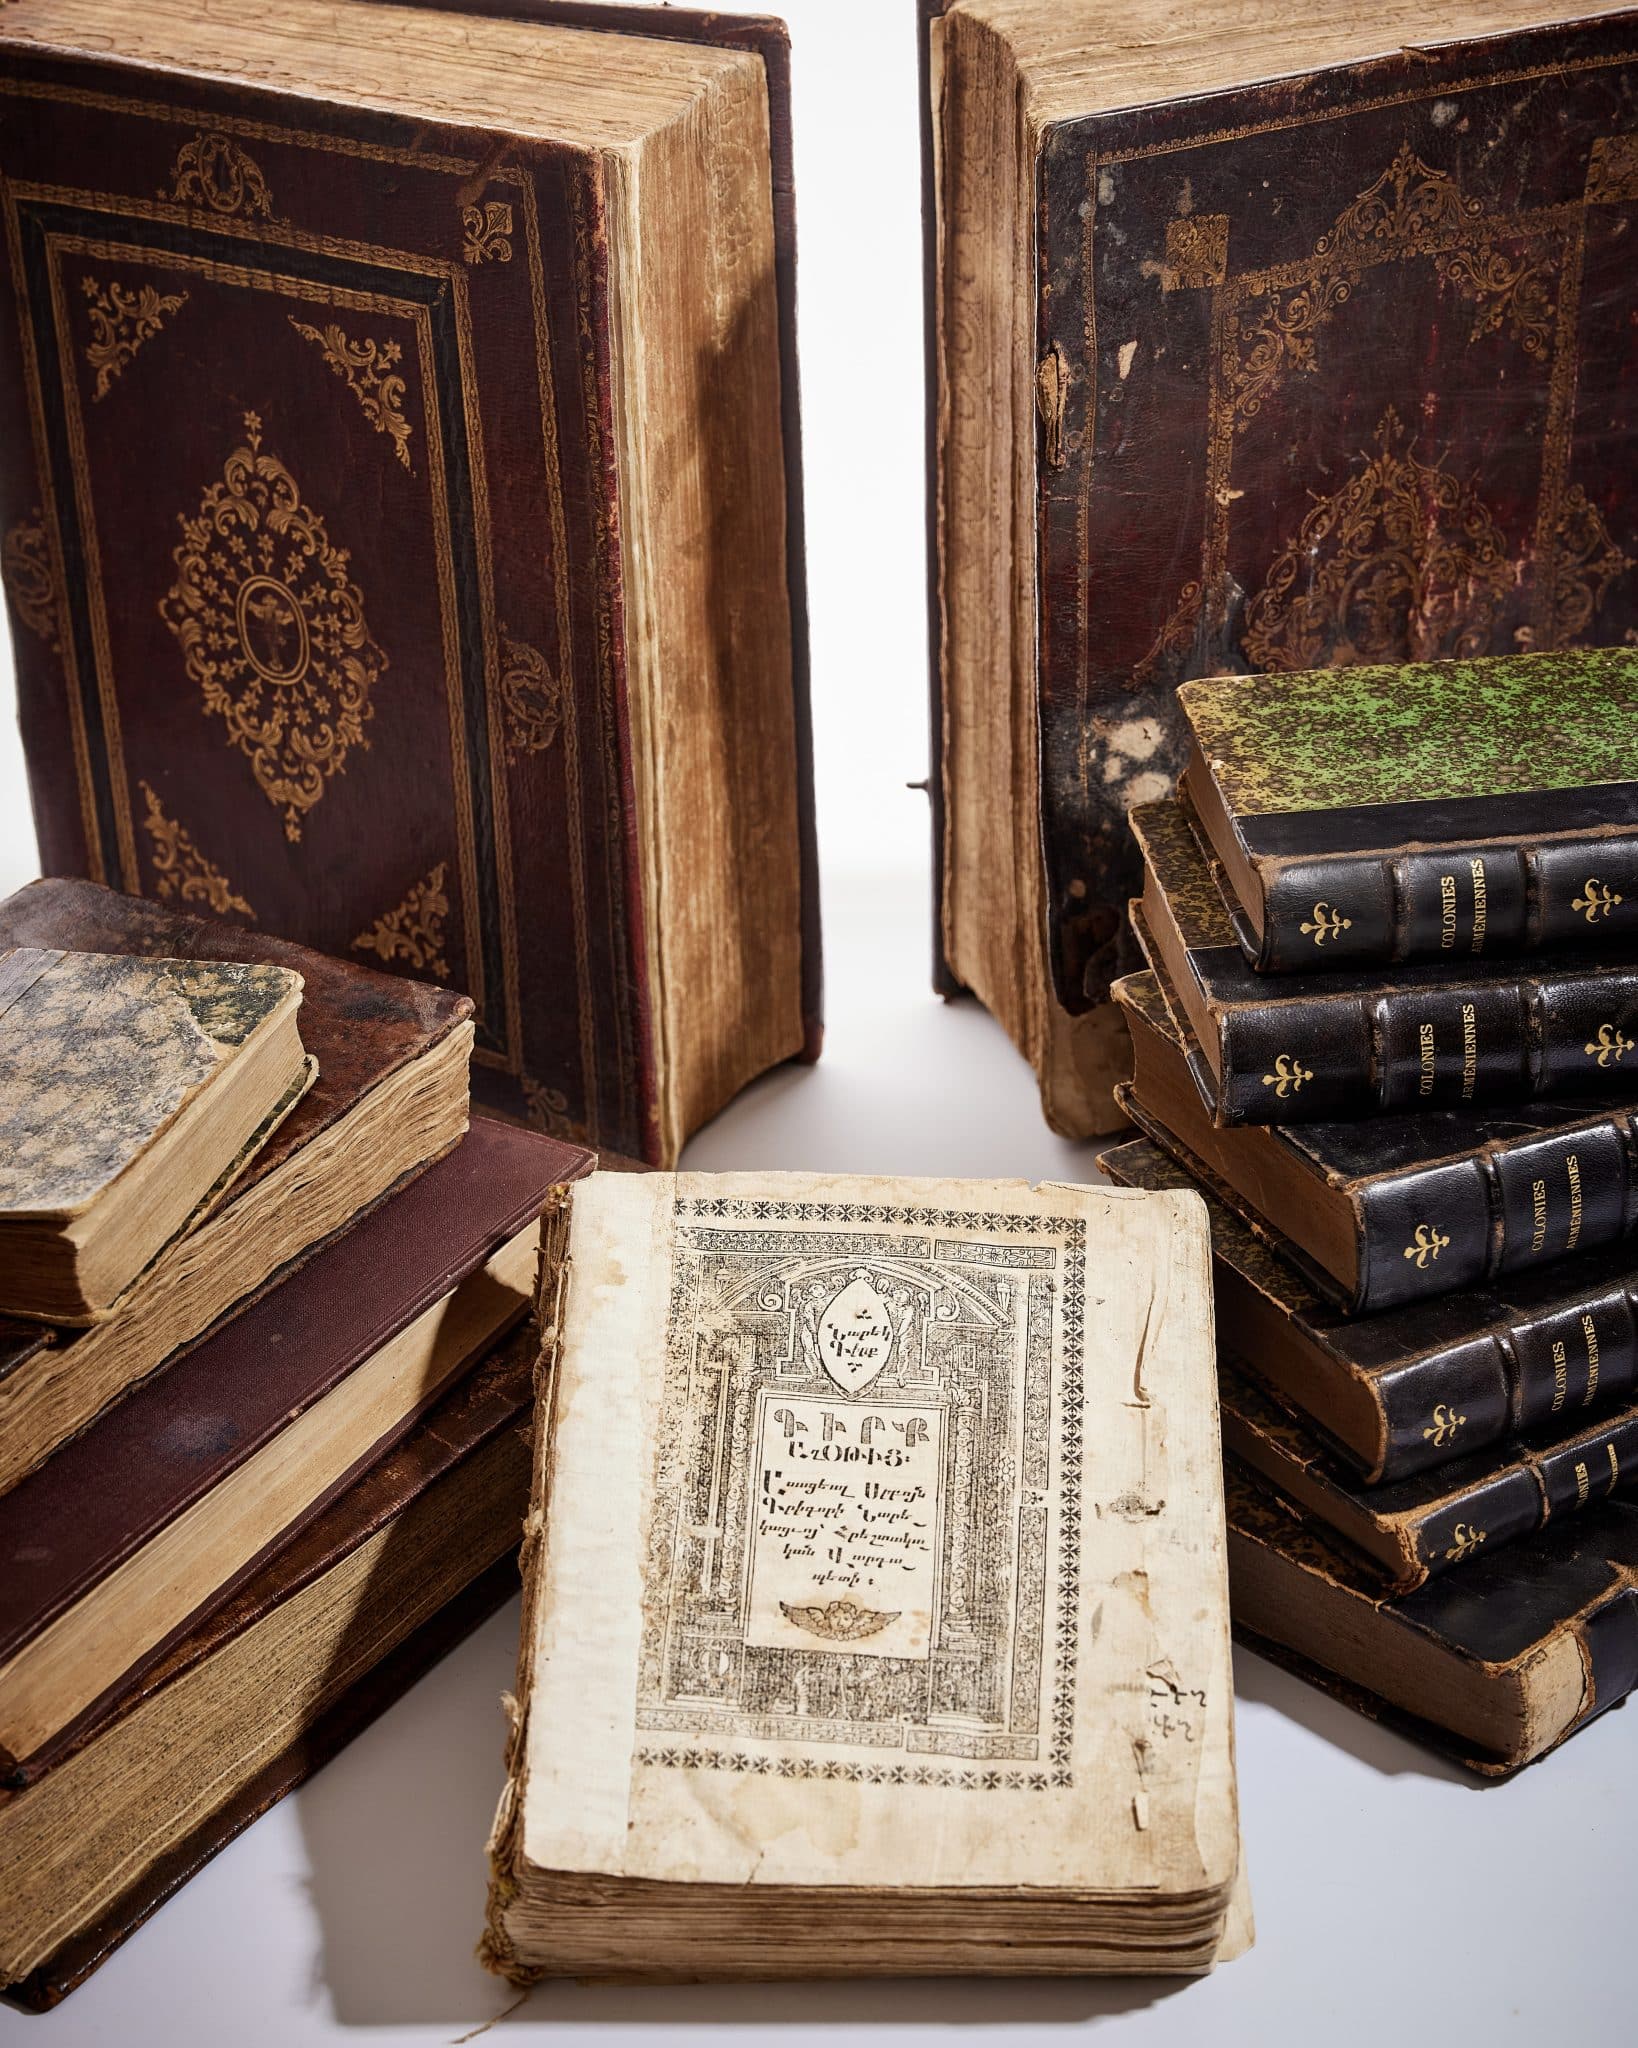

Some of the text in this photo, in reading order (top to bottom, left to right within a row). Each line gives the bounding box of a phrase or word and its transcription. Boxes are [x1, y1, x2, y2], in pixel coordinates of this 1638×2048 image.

[1441, 875, 1456, 948] COLONIES
[1419, 1023, 1435, 1096] COLONIES
[1531, 1179, 1546, 1252] COLONIES
[1552, 1341, 1567, 1411] COLONIES
